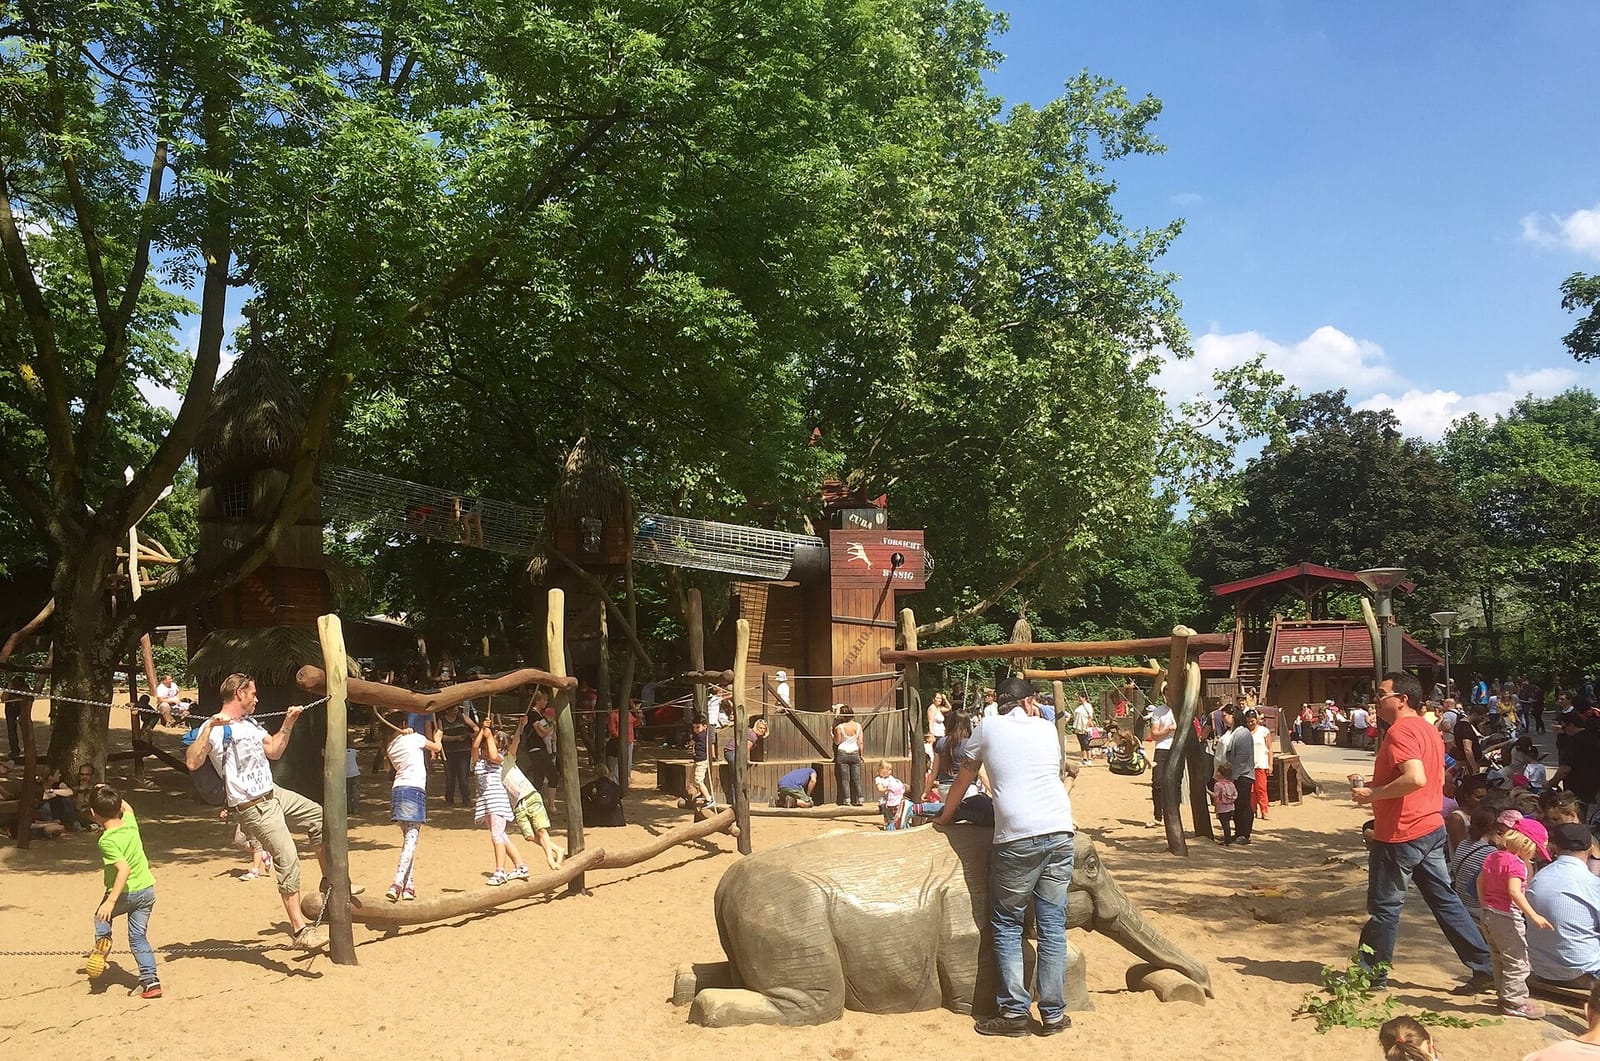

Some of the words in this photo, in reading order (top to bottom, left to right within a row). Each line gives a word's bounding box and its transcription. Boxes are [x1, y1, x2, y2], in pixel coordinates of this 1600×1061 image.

[848, 513, 873, 529] CUBA
[882, 537, 922, 550] VORSICHT
[882, 568, 914, 580] BSSIG
[1292, 645, 1327, 655] CAFE
[1281, 653, 1337, 664] ALMIRA
